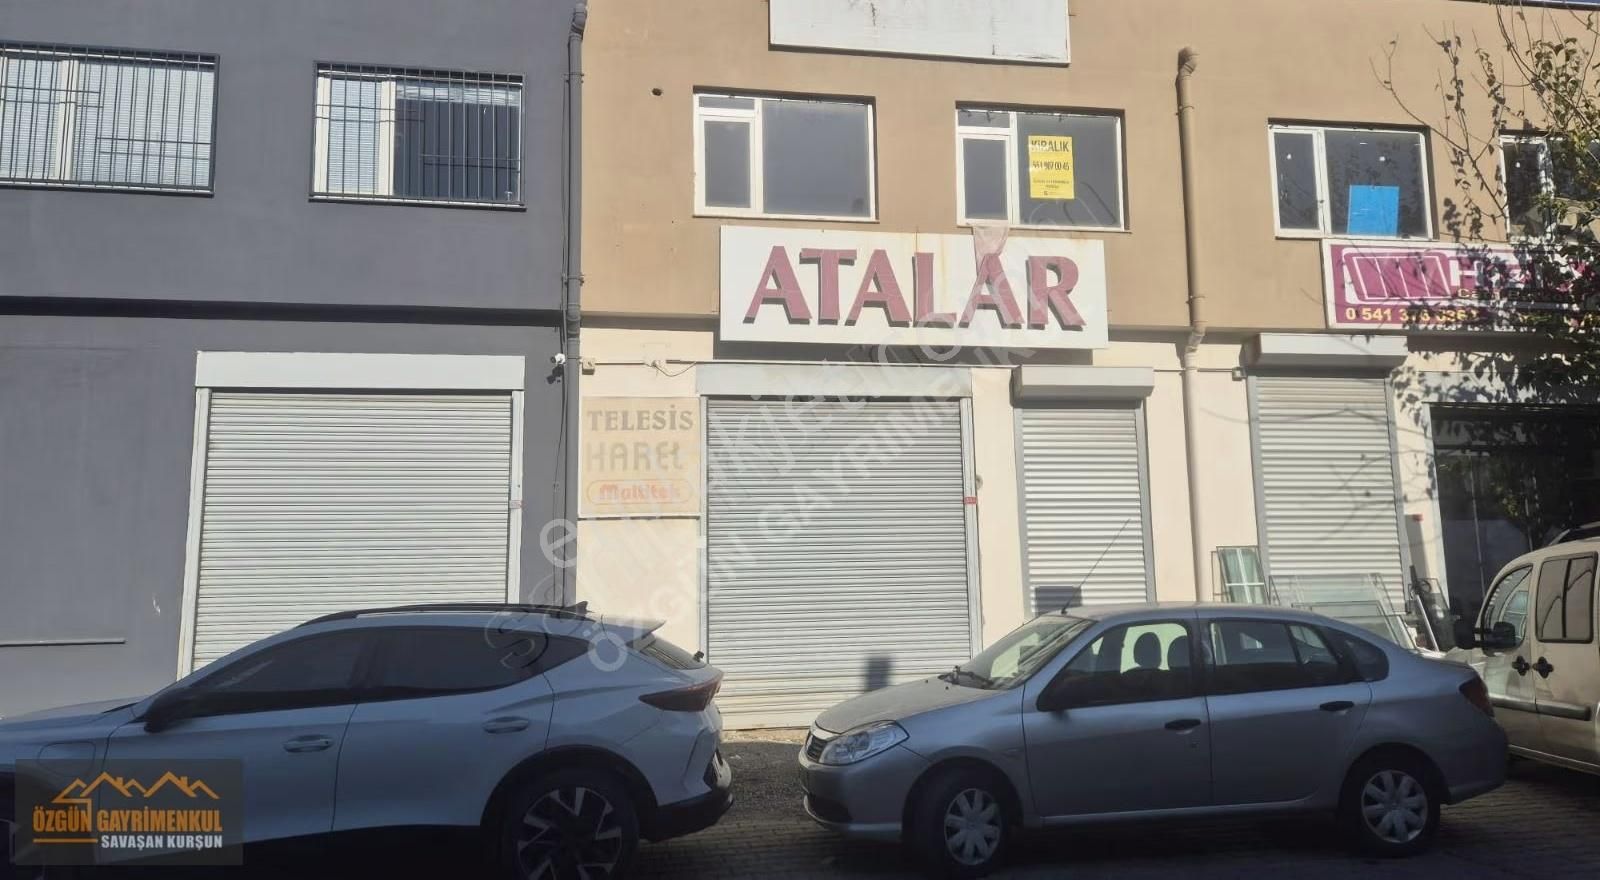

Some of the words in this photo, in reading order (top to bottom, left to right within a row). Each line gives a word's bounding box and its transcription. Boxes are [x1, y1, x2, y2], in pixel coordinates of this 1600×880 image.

[1031, 140, 1069, 152] KİRALIK
[743, 245, 1087, 332] ATALAR
[1346, 309, 1356, 320] 0
[1362, 308, 1392, 321] 541
[587, 404, 693, 431] TELESİS
